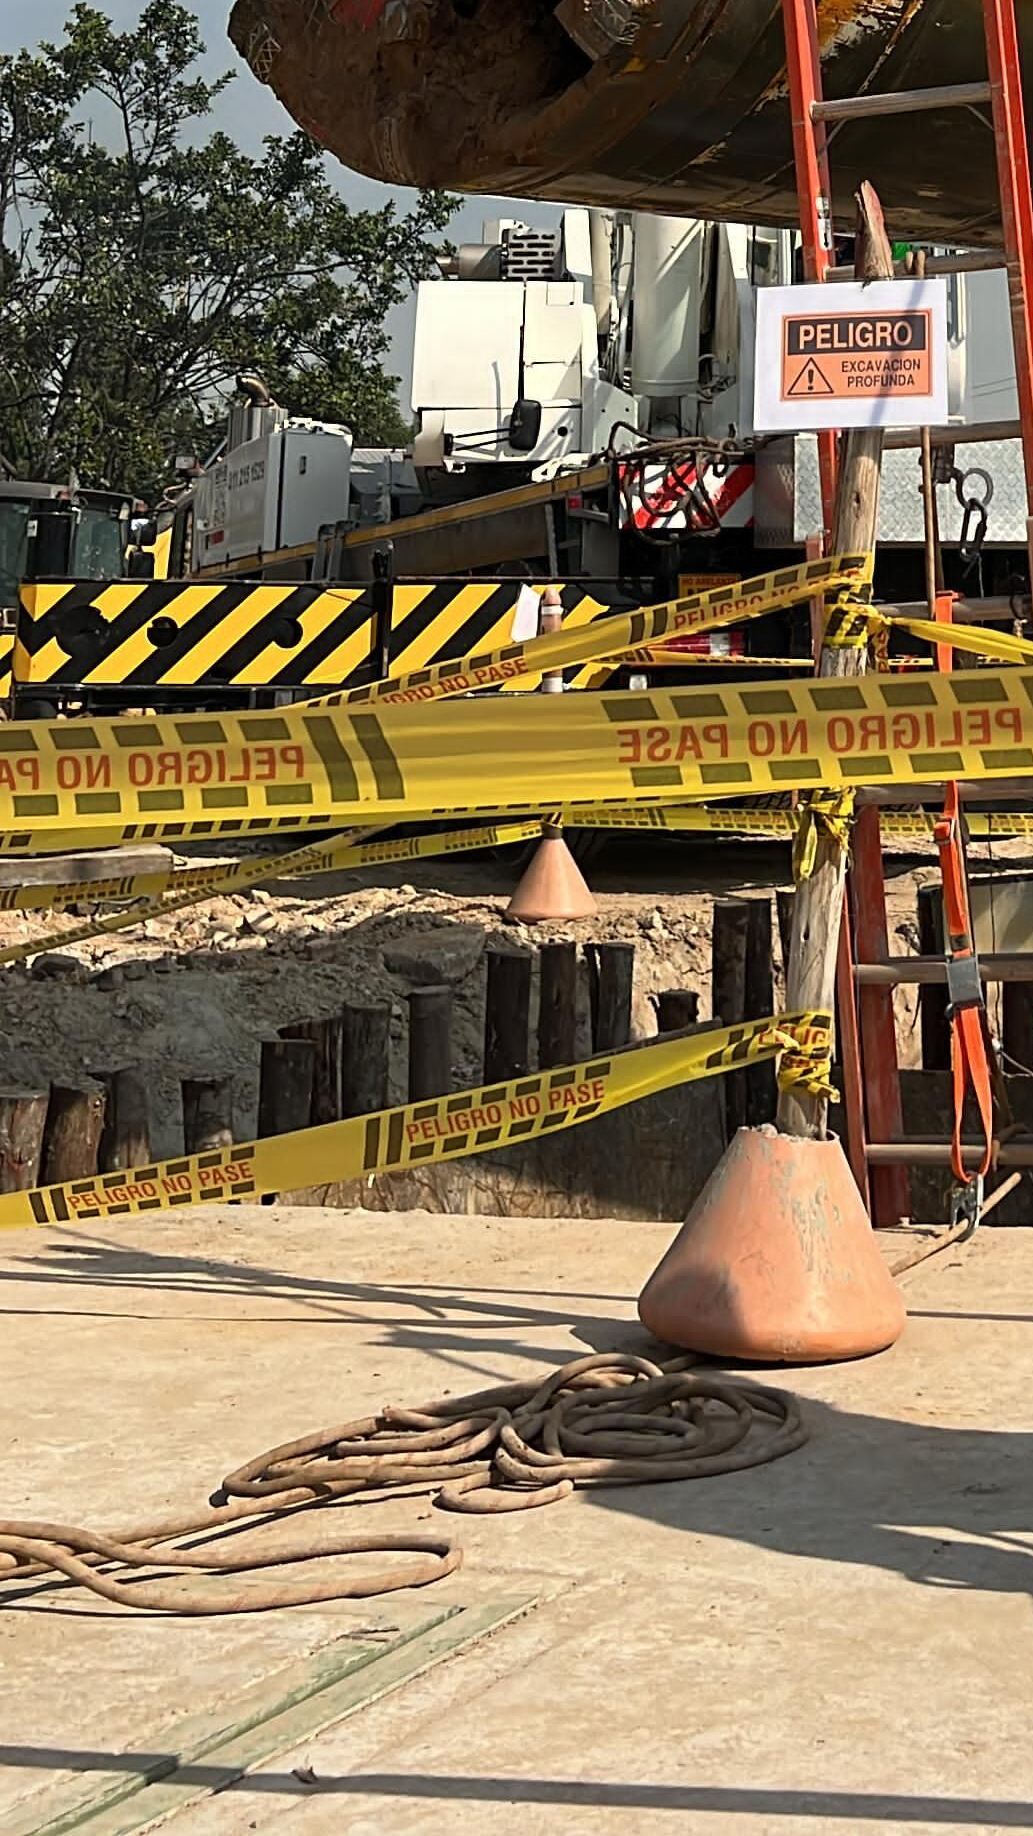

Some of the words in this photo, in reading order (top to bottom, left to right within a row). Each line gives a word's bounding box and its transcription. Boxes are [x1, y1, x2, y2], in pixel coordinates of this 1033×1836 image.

[799, 320, 913, 350] PELIGRO
[841, 358, 921, 373] EXCAVACION
[847, 374, 915, 388] PROFUNDA
[438, 674, 470, 694] NO
[474, 657, 529, 685] PASE
[406, 1103, 502, 1143] PELIGRO
[509, 1095, 541, 1119] NO
[549, 1080, 605, 1110] PASE
[67, 1182, 157, 1210] PELIGRO
[161, 1174, 193, 1194] NO
[199, 1162, 254, 1187] PASE
